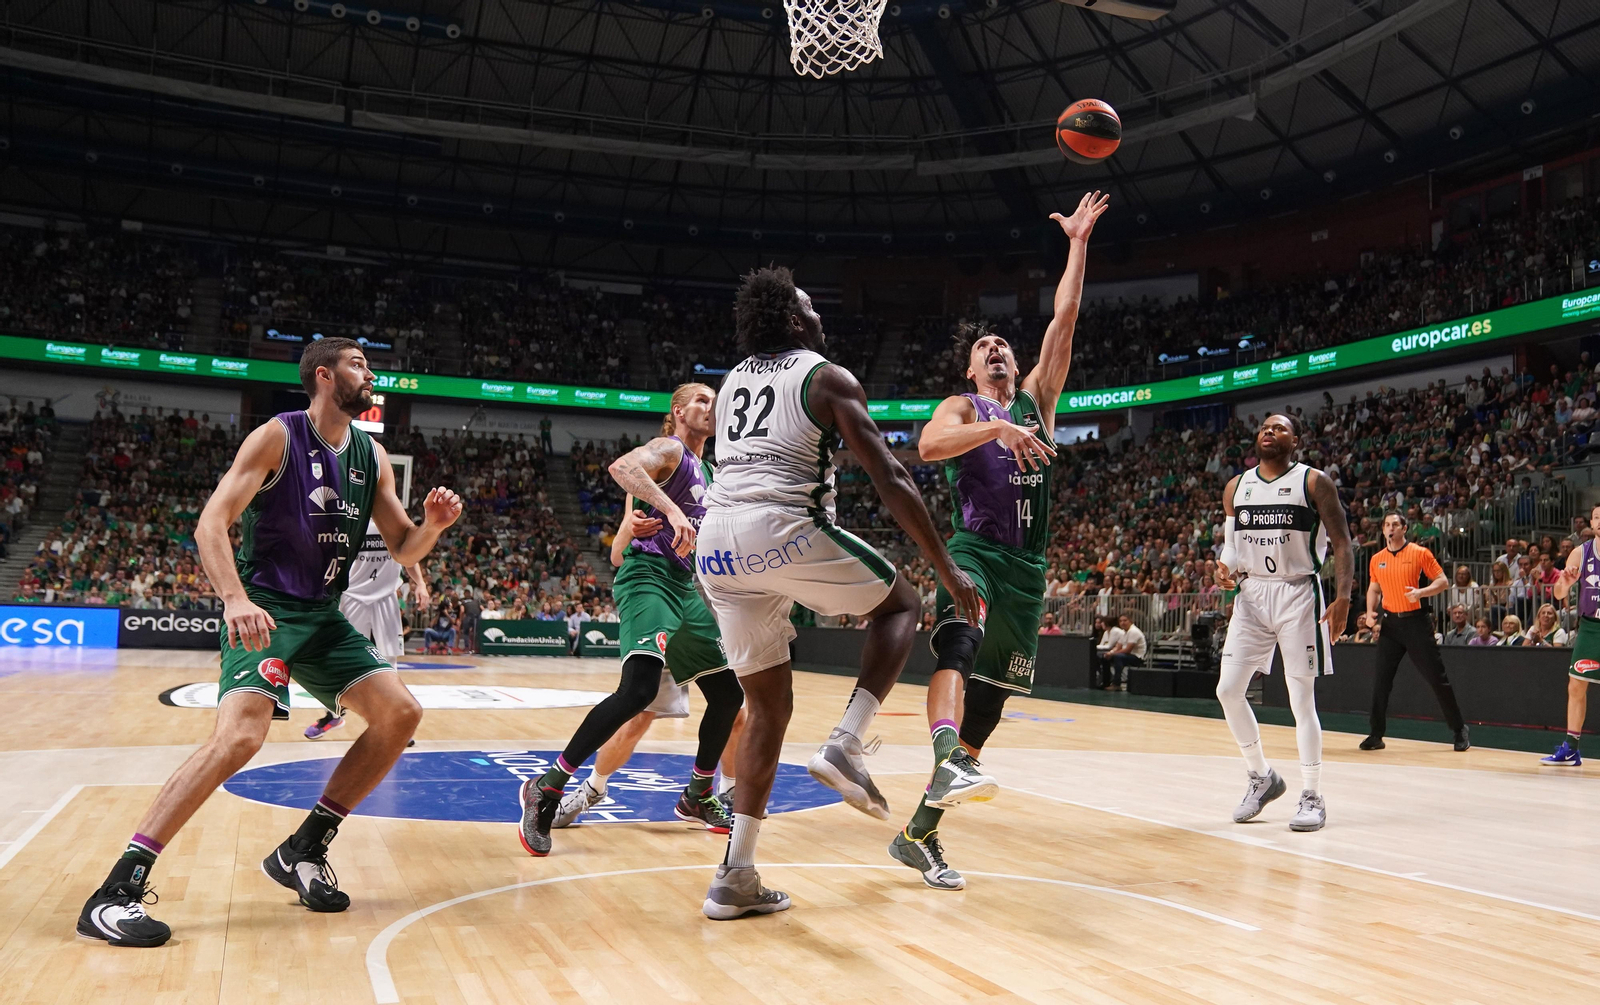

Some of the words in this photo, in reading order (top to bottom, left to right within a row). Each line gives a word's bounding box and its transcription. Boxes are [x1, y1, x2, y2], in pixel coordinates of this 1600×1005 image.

[1391, 318, 1492, 352] europcar.es
[45, 342, 87, 355] Europcar
[101, 348, 141, 361] Europcar
[159, 353, 198, 366] Europcar
[212, 358, 249, 370] Europcar
[1308, 351, 1337, 364] Europcar
[1271, 359, 1298, 372] Europcar
[1199, 374, 1225, 386] Europcar
[1233, 367, 1259, 380] Europcar
[481, 382, 515, 393] Europcar
[527, 386, 560, 396] Europcar
[575, 389, 607, 400] Europcar
[619, 393, 651, 403] Europcar
[1069, 387, 1152, 409] europcar.es
[727, 384, 776, 442] 32
[900, 403, 932, 411] Europcar
[1015, 498, 1034, 528] 14
[1252, 514, 1294, 526] PROBITAS
[1242, 533, 1291, 546] JOVENTUT
[1264, 555, 1277, 574] 0
[369, 568, 378, 581] 4
[124, 613, 220, 633] endesa
